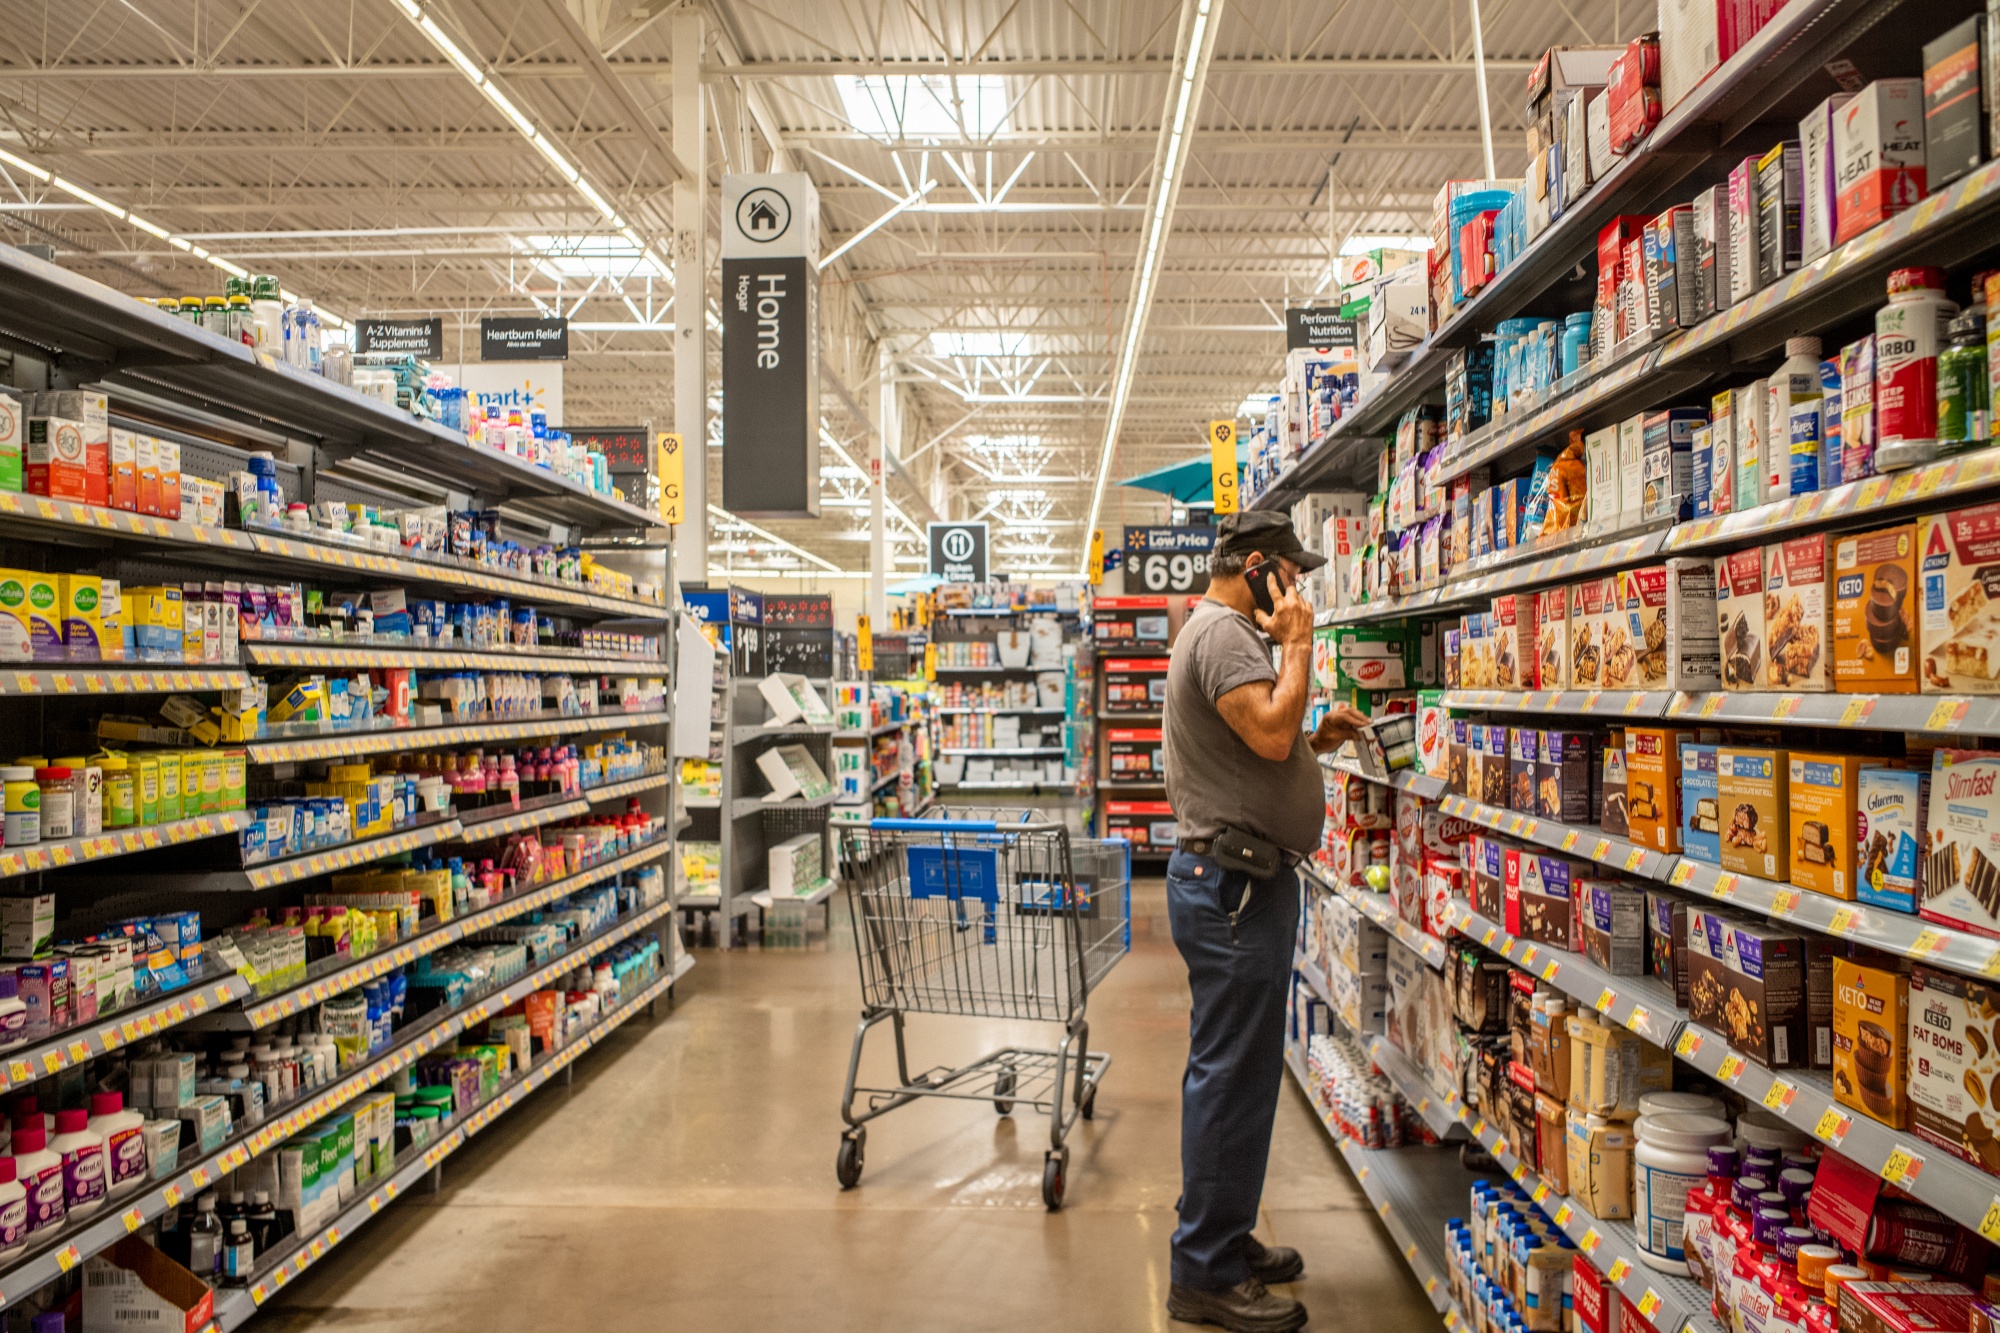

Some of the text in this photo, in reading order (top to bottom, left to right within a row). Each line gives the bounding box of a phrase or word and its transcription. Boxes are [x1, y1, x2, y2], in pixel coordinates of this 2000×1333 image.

[1883, 141, 1921, 152] HEAT
[1838, 151, 1873, 188] HEAT
[1645, 225, 1661, 330] HYDROXYCUT
[736, 274, 750, 312] Hogar
[1410, 306, 1419, 315] 24
[757, 274, 786, 369] Home
[1300, 313, 1357, 325] Performa
[366, 325, 431, 336] A-Z Vitamins &
[487, 328, 562, 341] Heartburn Relief
[1309, 325, 1351, 336] Nutrition
[369, 337, 428, 350] Supplements
[1790, 419, 1814, 435] diurex
[1622, 438, 1638, 467] alli
[1595, 451, 1612, 485] alli
[1220, 473, 1233, 487] G
[664, 484, 678, 498] G
[1222, 495, 1231, 508] 5
[666, 505, 677, 519] 4
[1149, 534, 1209, 547] Low Price
[1925, 556, 1948, 569] ATKINS
[1838, 580, 1862, 595] KETO
[1359, 662, 1385, 678] BOOST
[1684, 777, 1711, 787] CHOCOLATE
[1945, 768, 1997, 800] SlimFast
[1733, 786, 1754, 794] CHOCOLATE
[1762, 789, 1773, 797] ROLL
[1790, 794, 1833, 806] CARAMEL CHOCOLATE
[1790, 802, 1821, 812] PEANUT NOUGAT
[1868, 792, 1904, 811] Glucerna
[1507, 860, 1516, 875] 10
[1835, 875, 1841, 885] 5
[1505, 884, 1519, 894] VALUE
[1506, 891, 1518, 902] PACK
[182, 922, 199, 937] Fortify
[21, 977, 43, 985] colon
[52, 978, 68, 990] colon
[1838, 984, 1867, 1010] KETO
[1925, 1012, 1950, 1030] KETO
[1913, 1024, 1963, 1056] FAT BOMB
[1936, 1050, 1962, 1065] SNACK CUP
[1916, 1106, 1962, 1134] Peanut Butter Chocolate
[111, 1130, 136, 1145] Value Size
[338, 1131, 354, 1150] Fleet
[321, 1146, 338, 1165] Fleet
[302, 1160, 319, 1178] Fleet
[1581, 1278, 1601, 1301] VALUE
[1583, 1295, 1600, 1322] PACK
[1739, 1285, 1769, 1323] SlimFast
